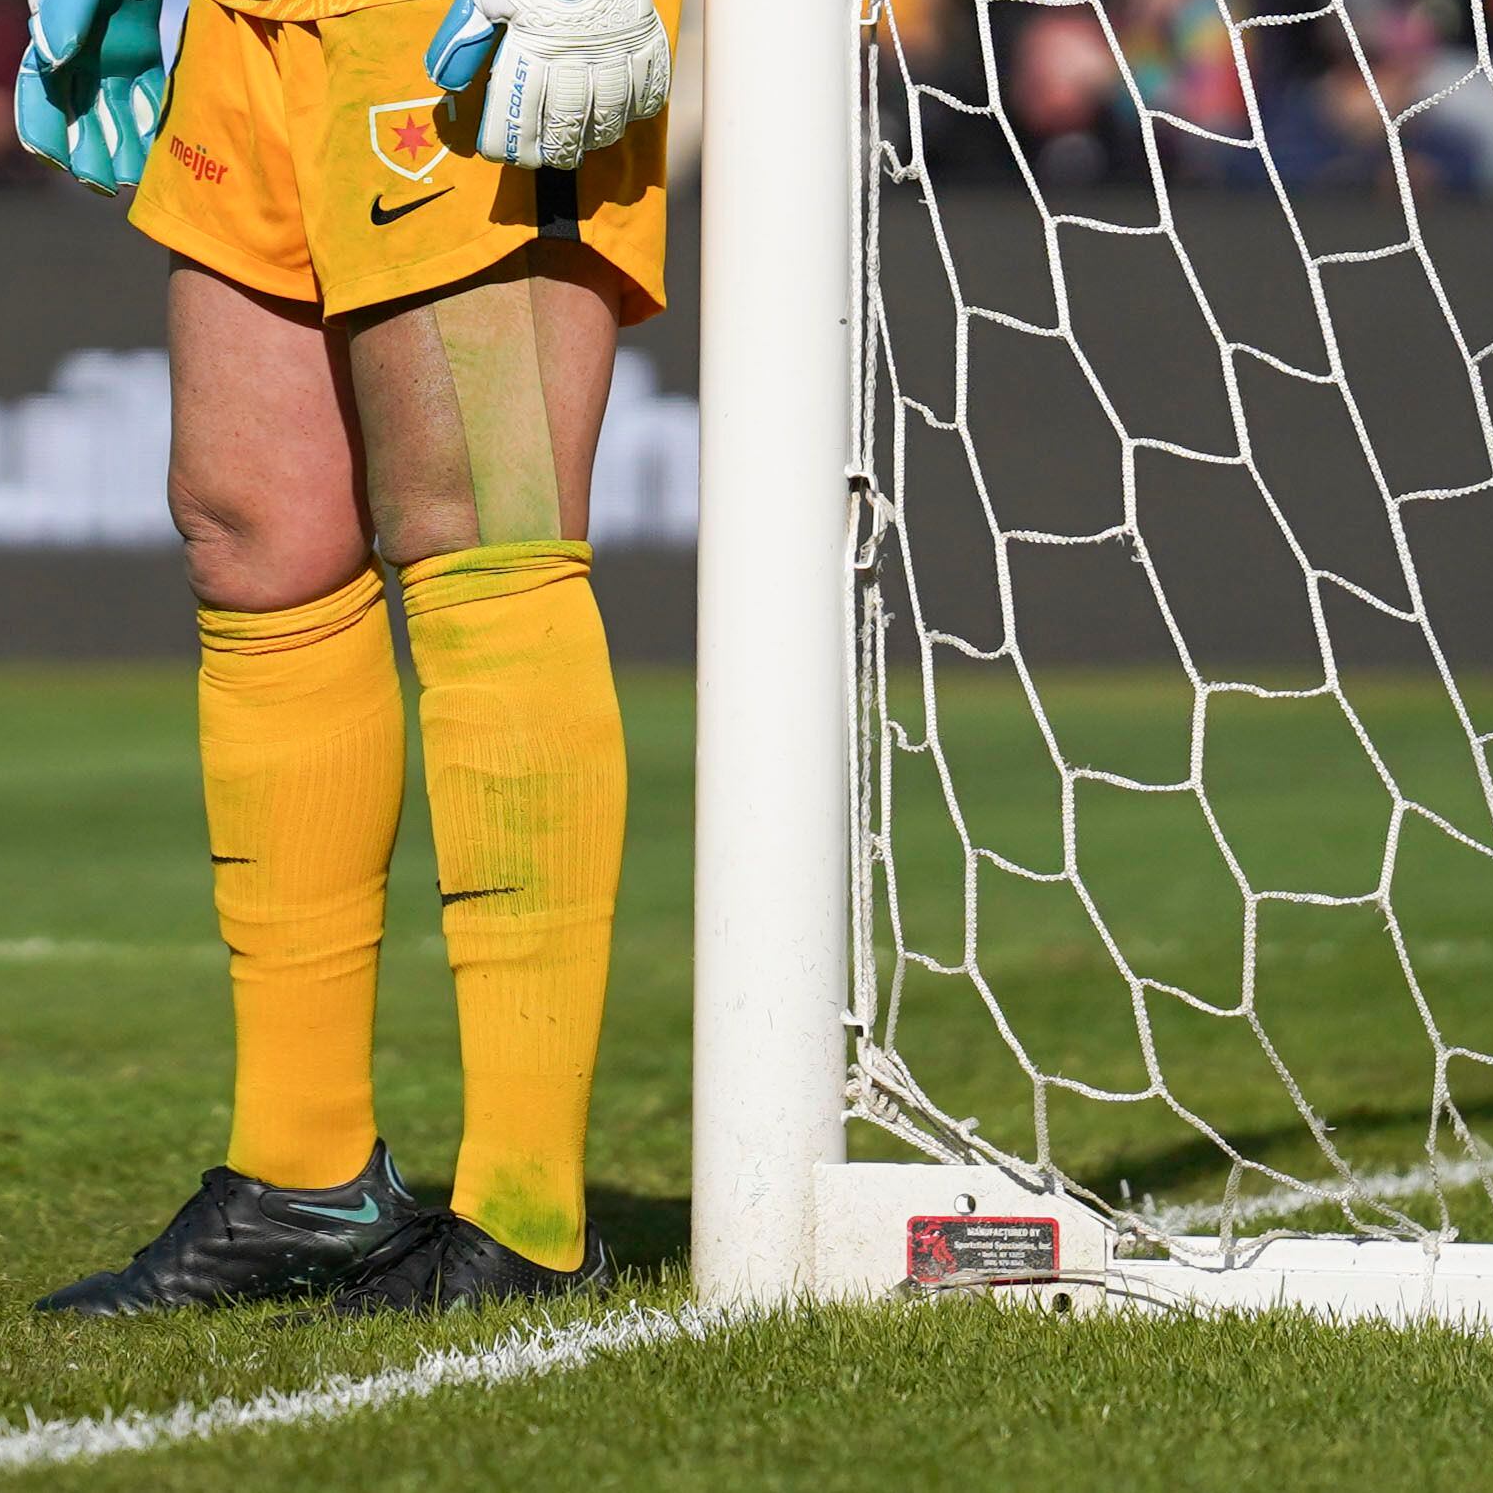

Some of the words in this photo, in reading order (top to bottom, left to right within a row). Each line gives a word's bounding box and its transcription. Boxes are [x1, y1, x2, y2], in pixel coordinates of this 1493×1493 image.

[509, 55, 529, 119] COAST
[169, 135, 229, 185] meijer
[967, 1227, 1028, 1237] MANUFACTURED
